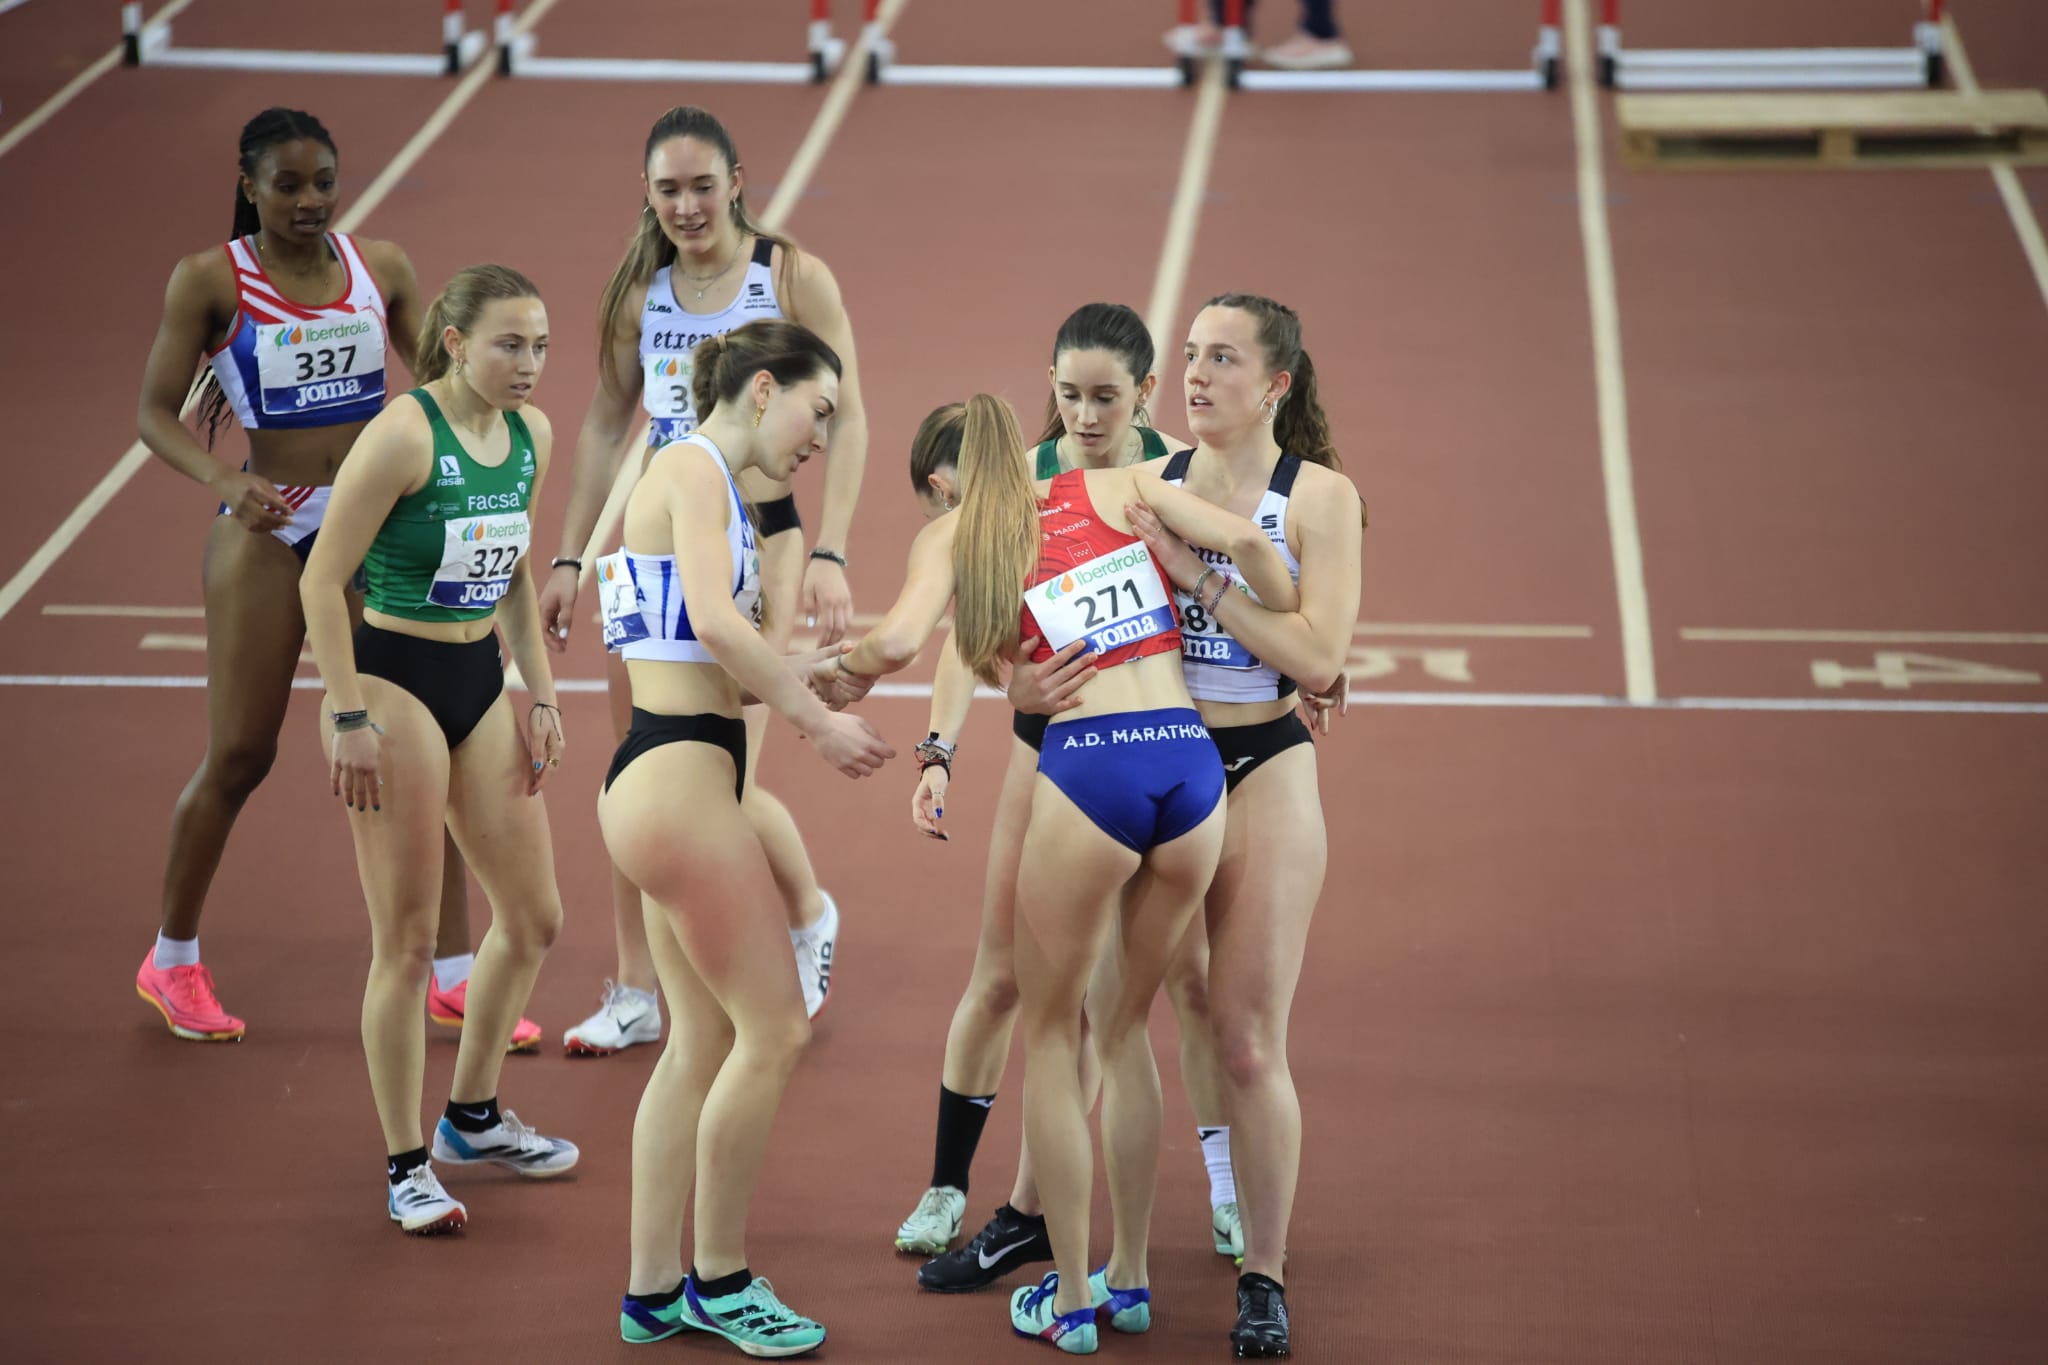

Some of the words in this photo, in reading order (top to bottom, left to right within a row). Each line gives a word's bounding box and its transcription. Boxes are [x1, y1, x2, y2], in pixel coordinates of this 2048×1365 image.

[305, 319, 371, 343] Iberdrola
[295, 345, 357, 382] 337
[1053, 518, 1090, 537] MADRID
[468, 545, 519, 578] 322
[1075, 549, 1148, 587] Iberdrola
[1074, 578, 1145, 630] 271
[1184, 639, 1231, 660] ma
[1811, 651, 2043, 690] 4
[1063, 733, 1106, 751] A.D.
[1112, 723, 1211, 745] MARATHON
